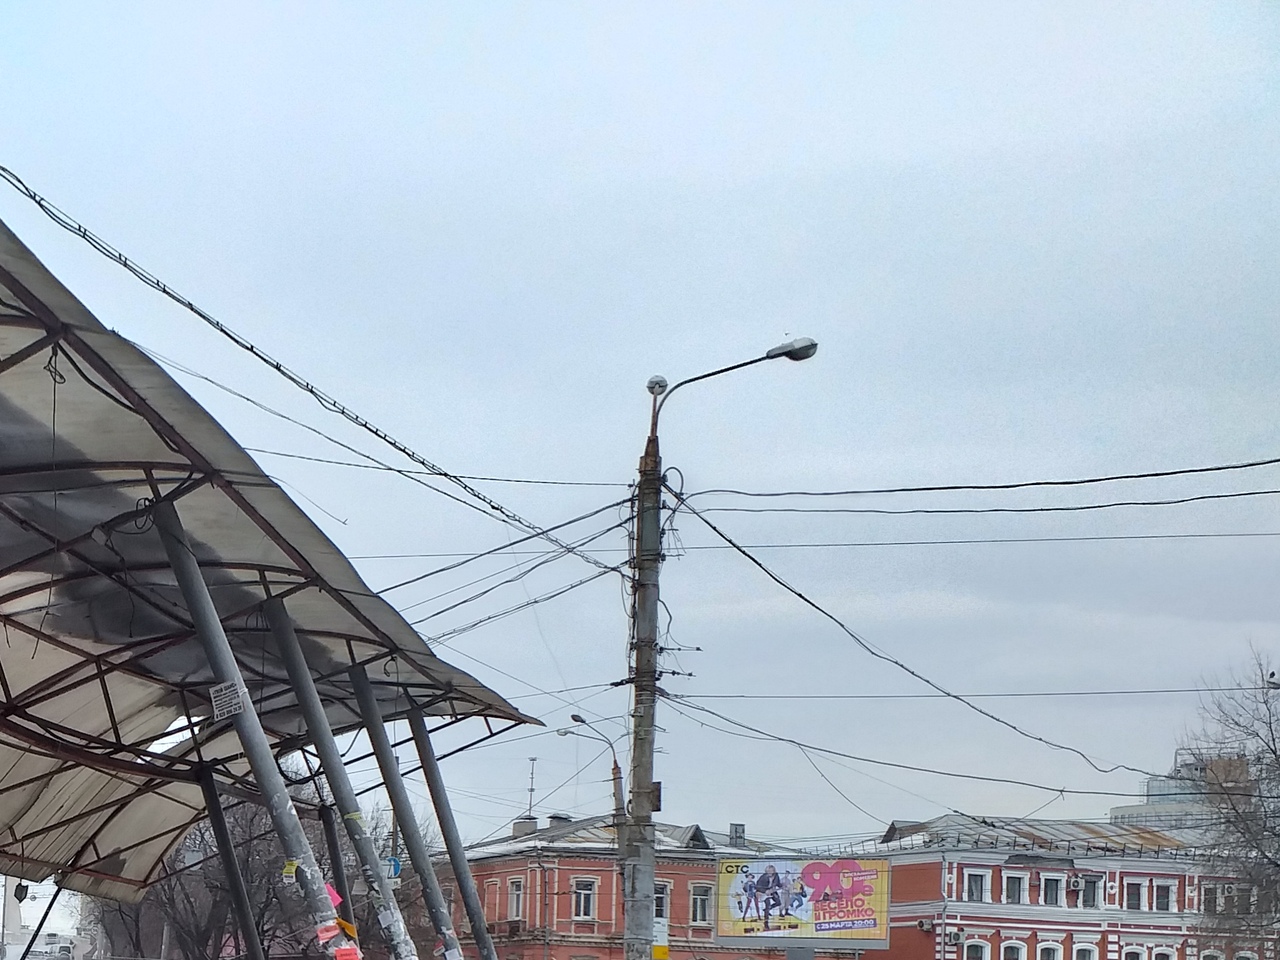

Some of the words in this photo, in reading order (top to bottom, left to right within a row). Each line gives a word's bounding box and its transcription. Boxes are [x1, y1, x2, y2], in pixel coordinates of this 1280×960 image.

[725, 865, 750, 874] СТС
[813, 897, 865, 912] ВЕСЕЛО
[823, 907, 875, 920] ГРОМКО
[830, 921, 852, 929] МАРТА
